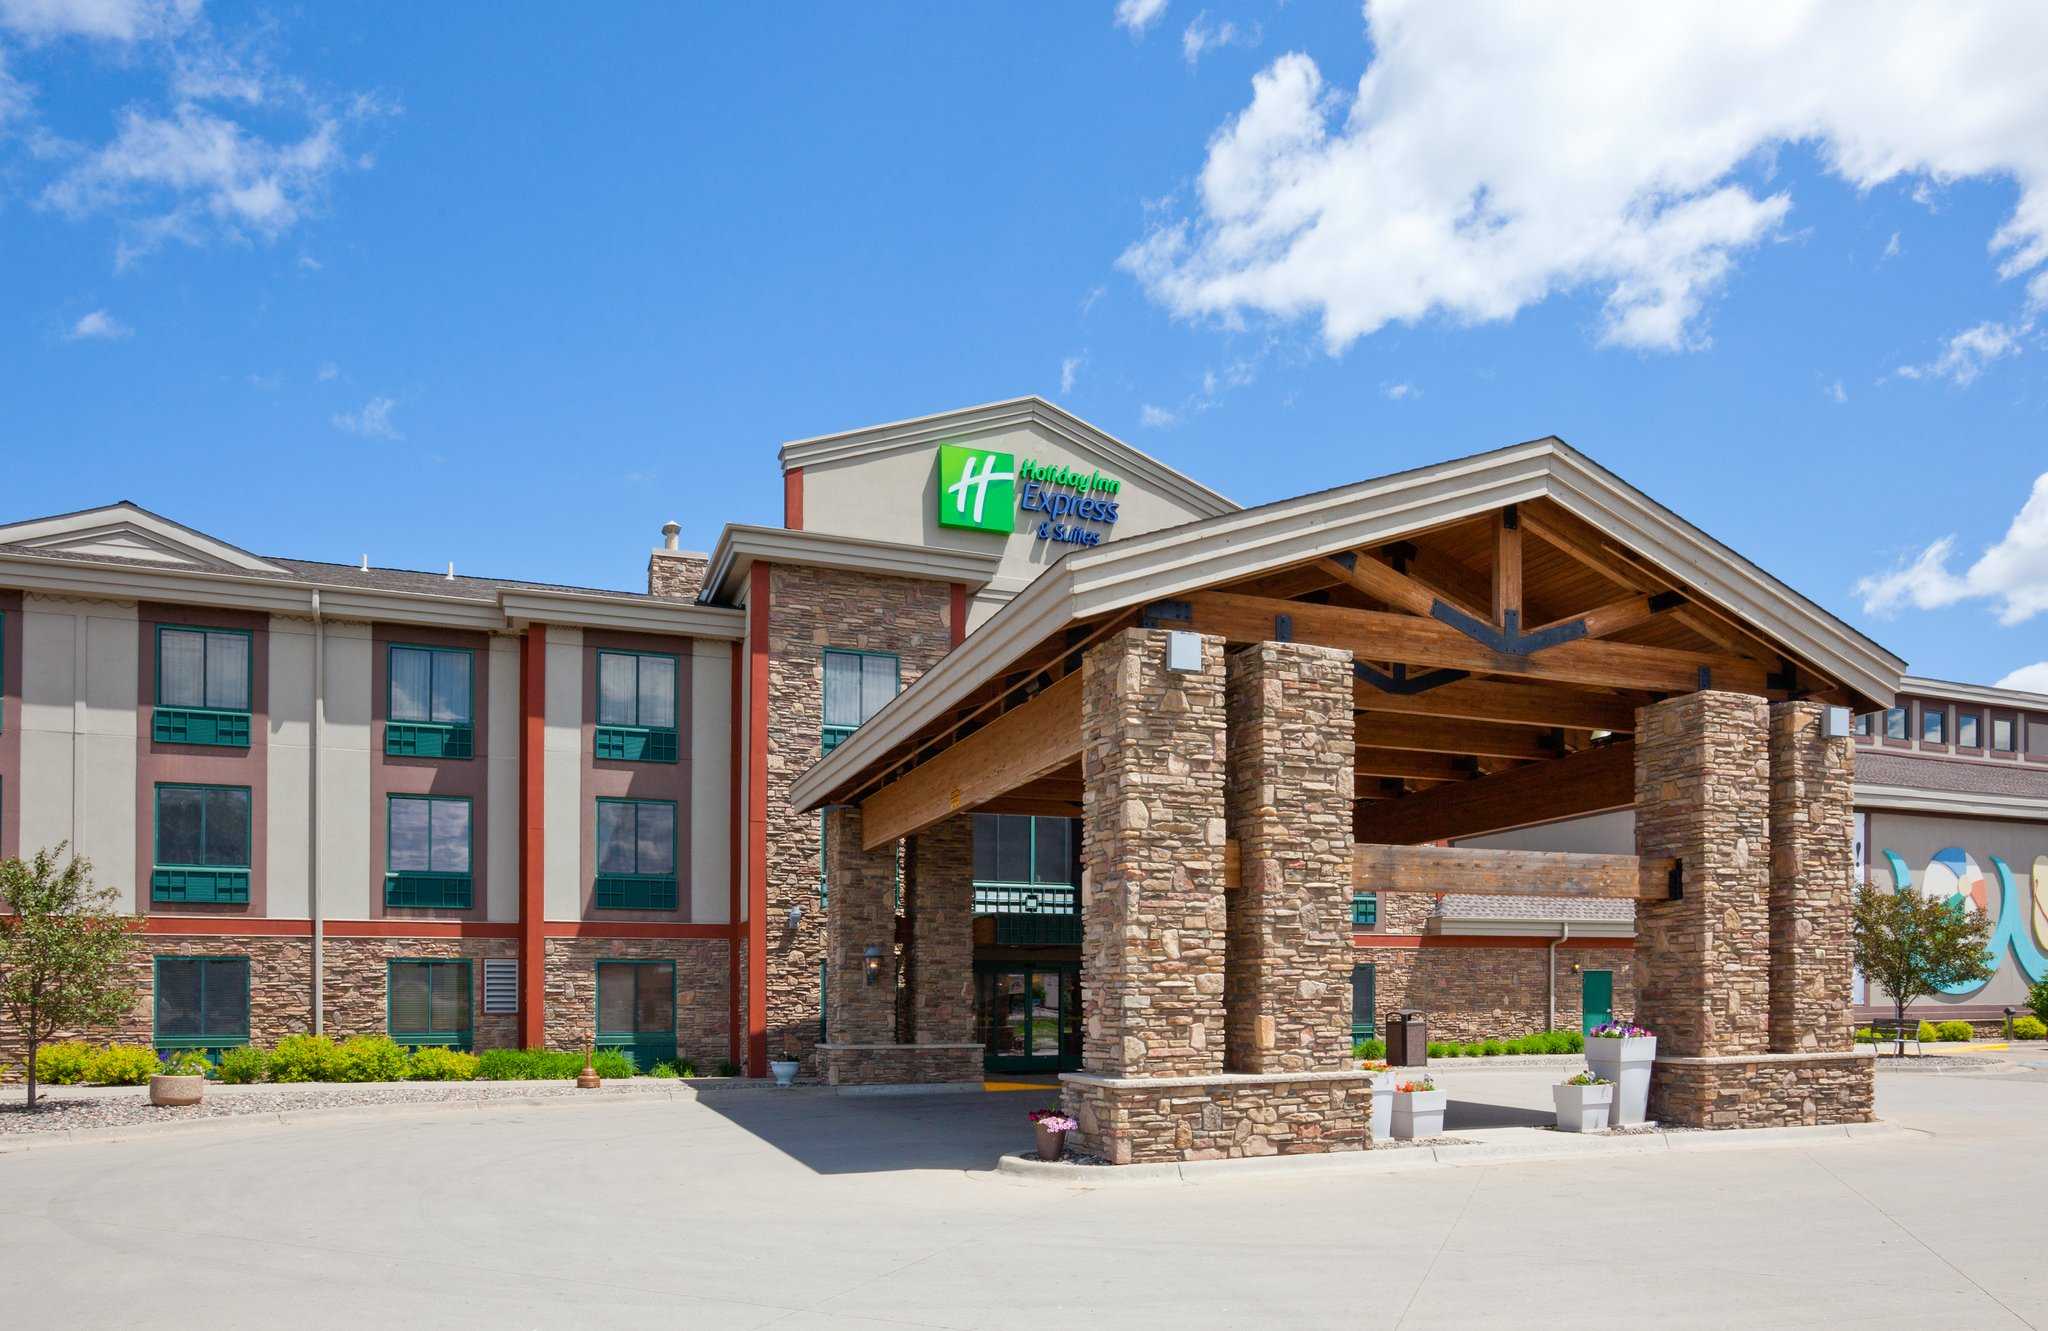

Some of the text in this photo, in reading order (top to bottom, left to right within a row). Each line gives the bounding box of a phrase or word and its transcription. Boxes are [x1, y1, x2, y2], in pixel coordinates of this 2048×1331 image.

[1020, 459, 1121, 495] Holiday Inn
[1021, 482, 1120, 524] Express
[1038, 521, 1101, 546] & Suites
